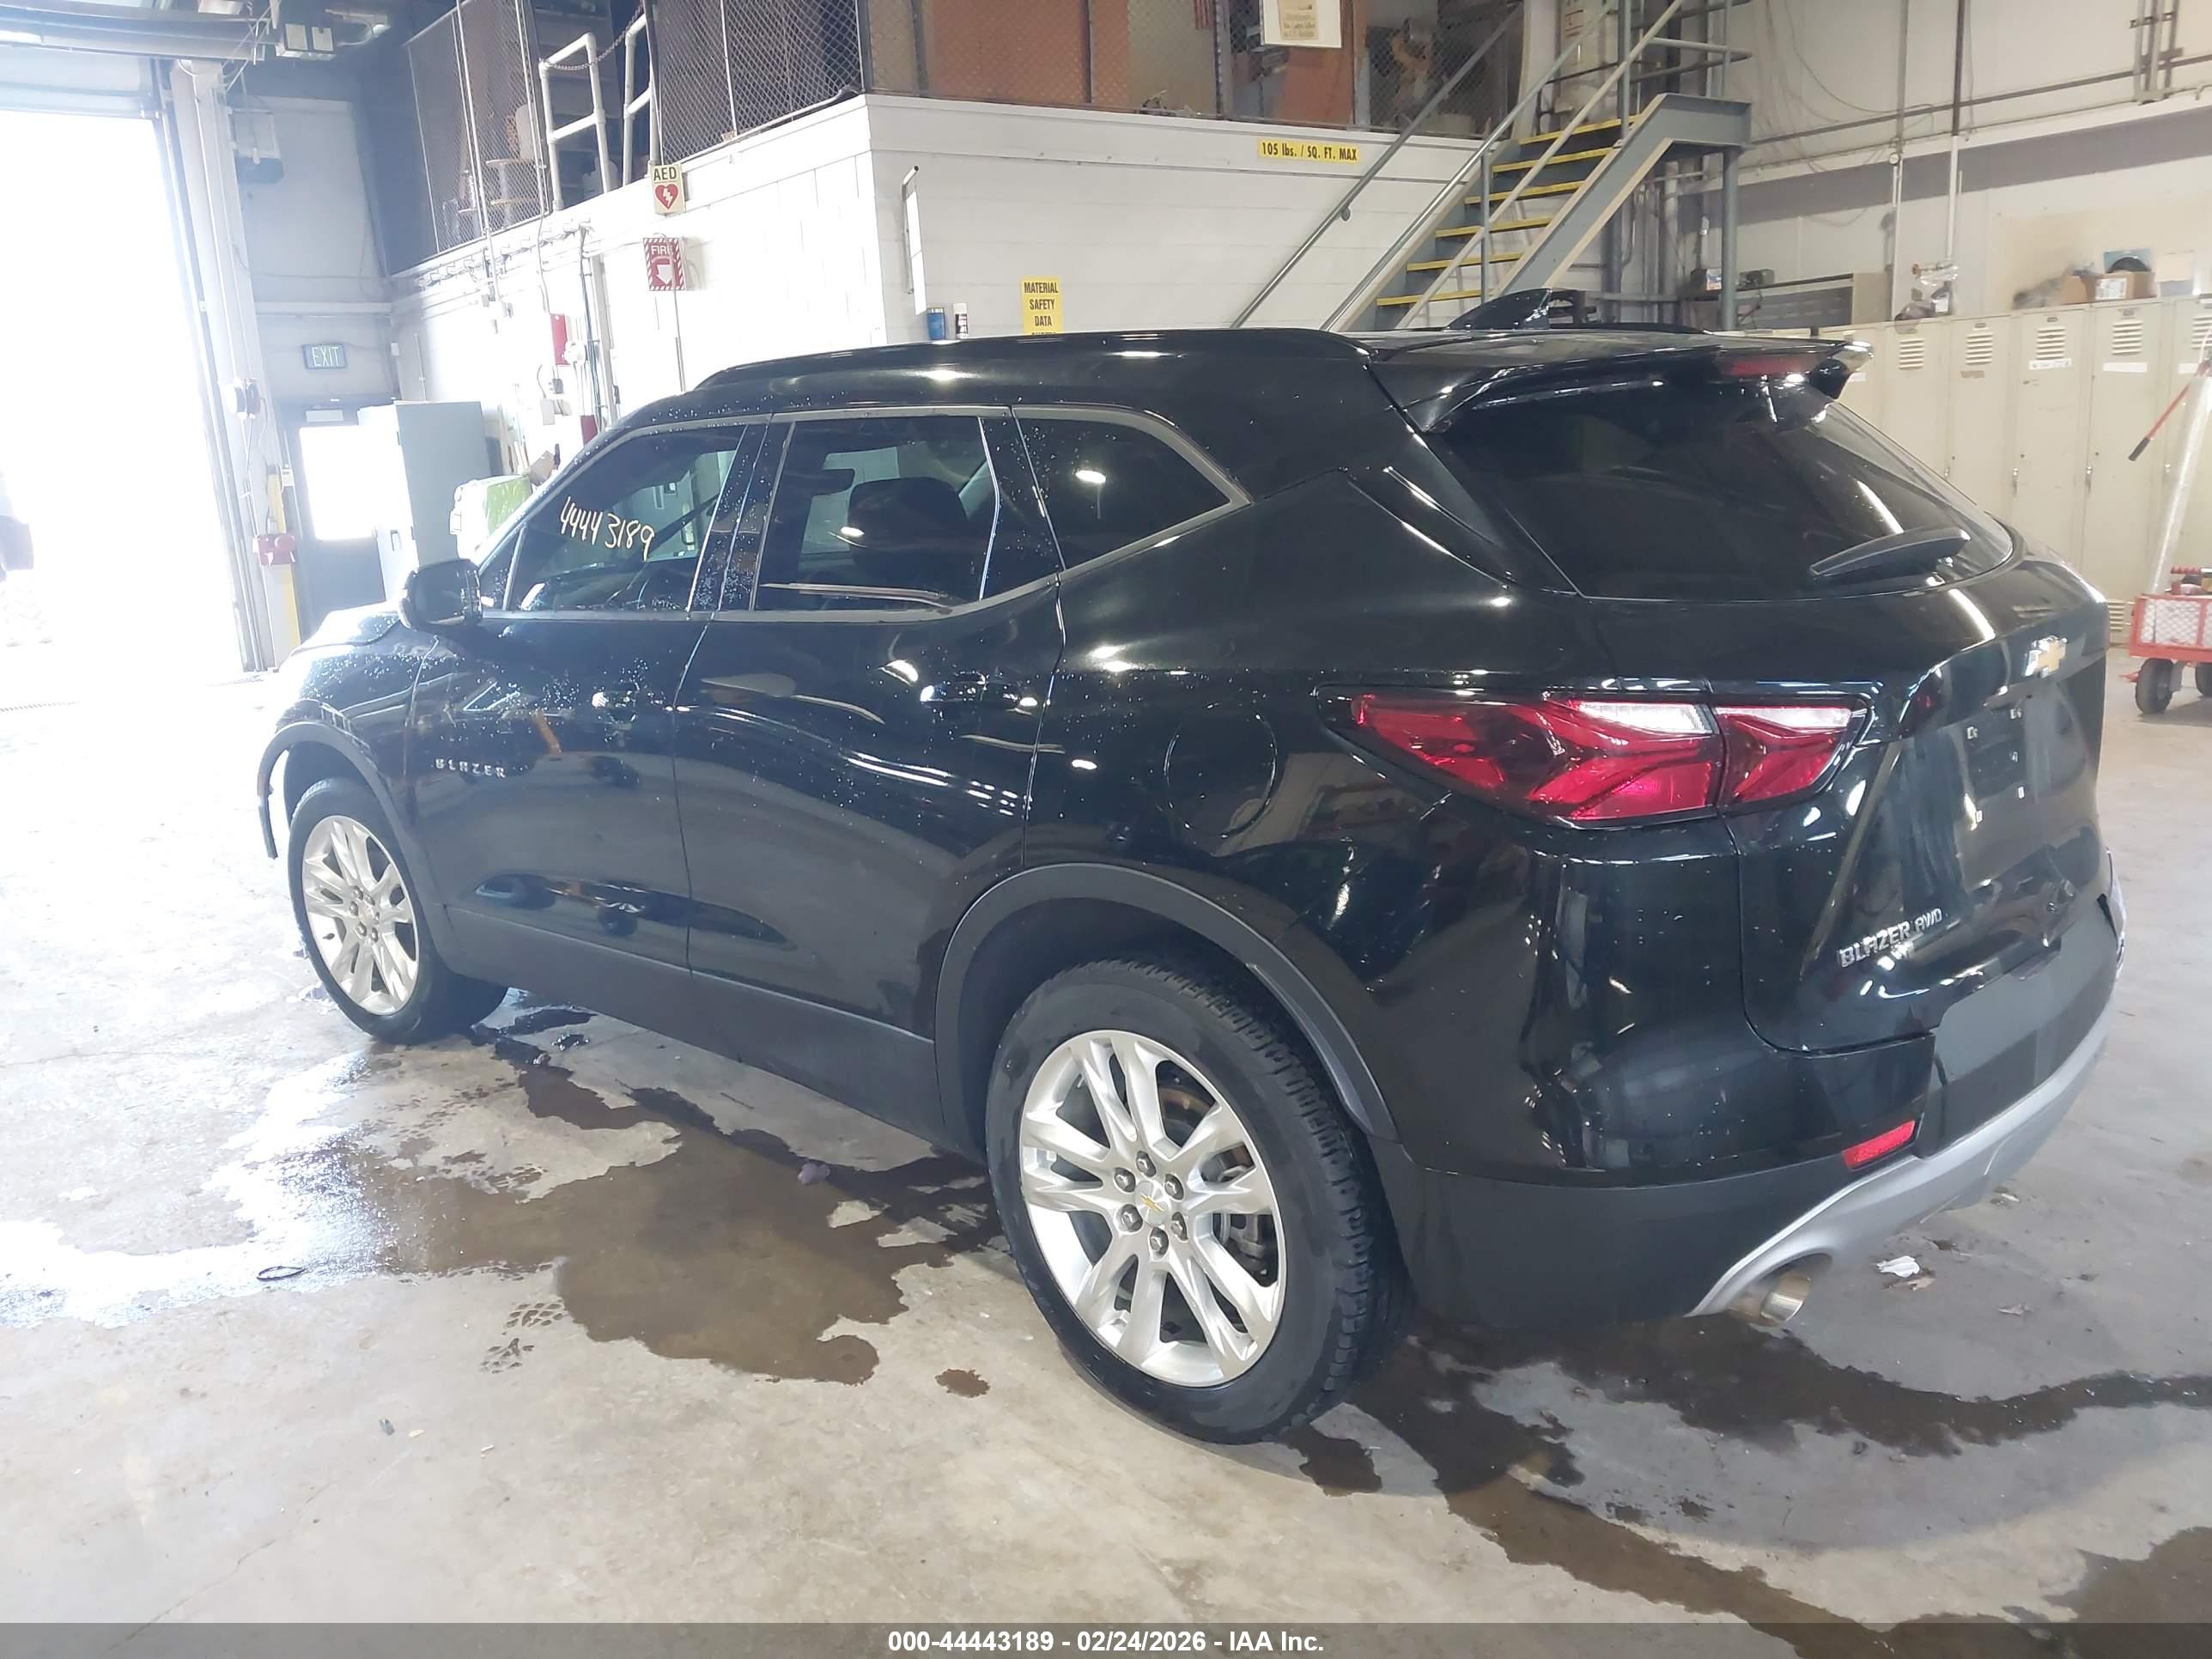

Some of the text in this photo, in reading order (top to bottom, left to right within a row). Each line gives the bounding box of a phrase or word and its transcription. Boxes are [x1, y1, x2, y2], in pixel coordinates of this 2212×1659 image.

[1262, 143, 1279, 155] 105
[1281, 143, 1297, 156] lbs.
[1307, 145, 1321, 159] SQ.
[1324, 147, 1336, 160] FT.
[1339, 148, 1358, 161] MAX
[653, 167, 677, 181] AED
[1024, 282, 1059, 294] MATERIAL
[1030, 299, 1055, 310] SAFETY
[1035, 315, 1053, 327] DATA
[311, 345, 339, 367] EXIT
[435, 758, 507, 779] BLAZER
[1838, 908, 1943, 968] BLAZER AWD
